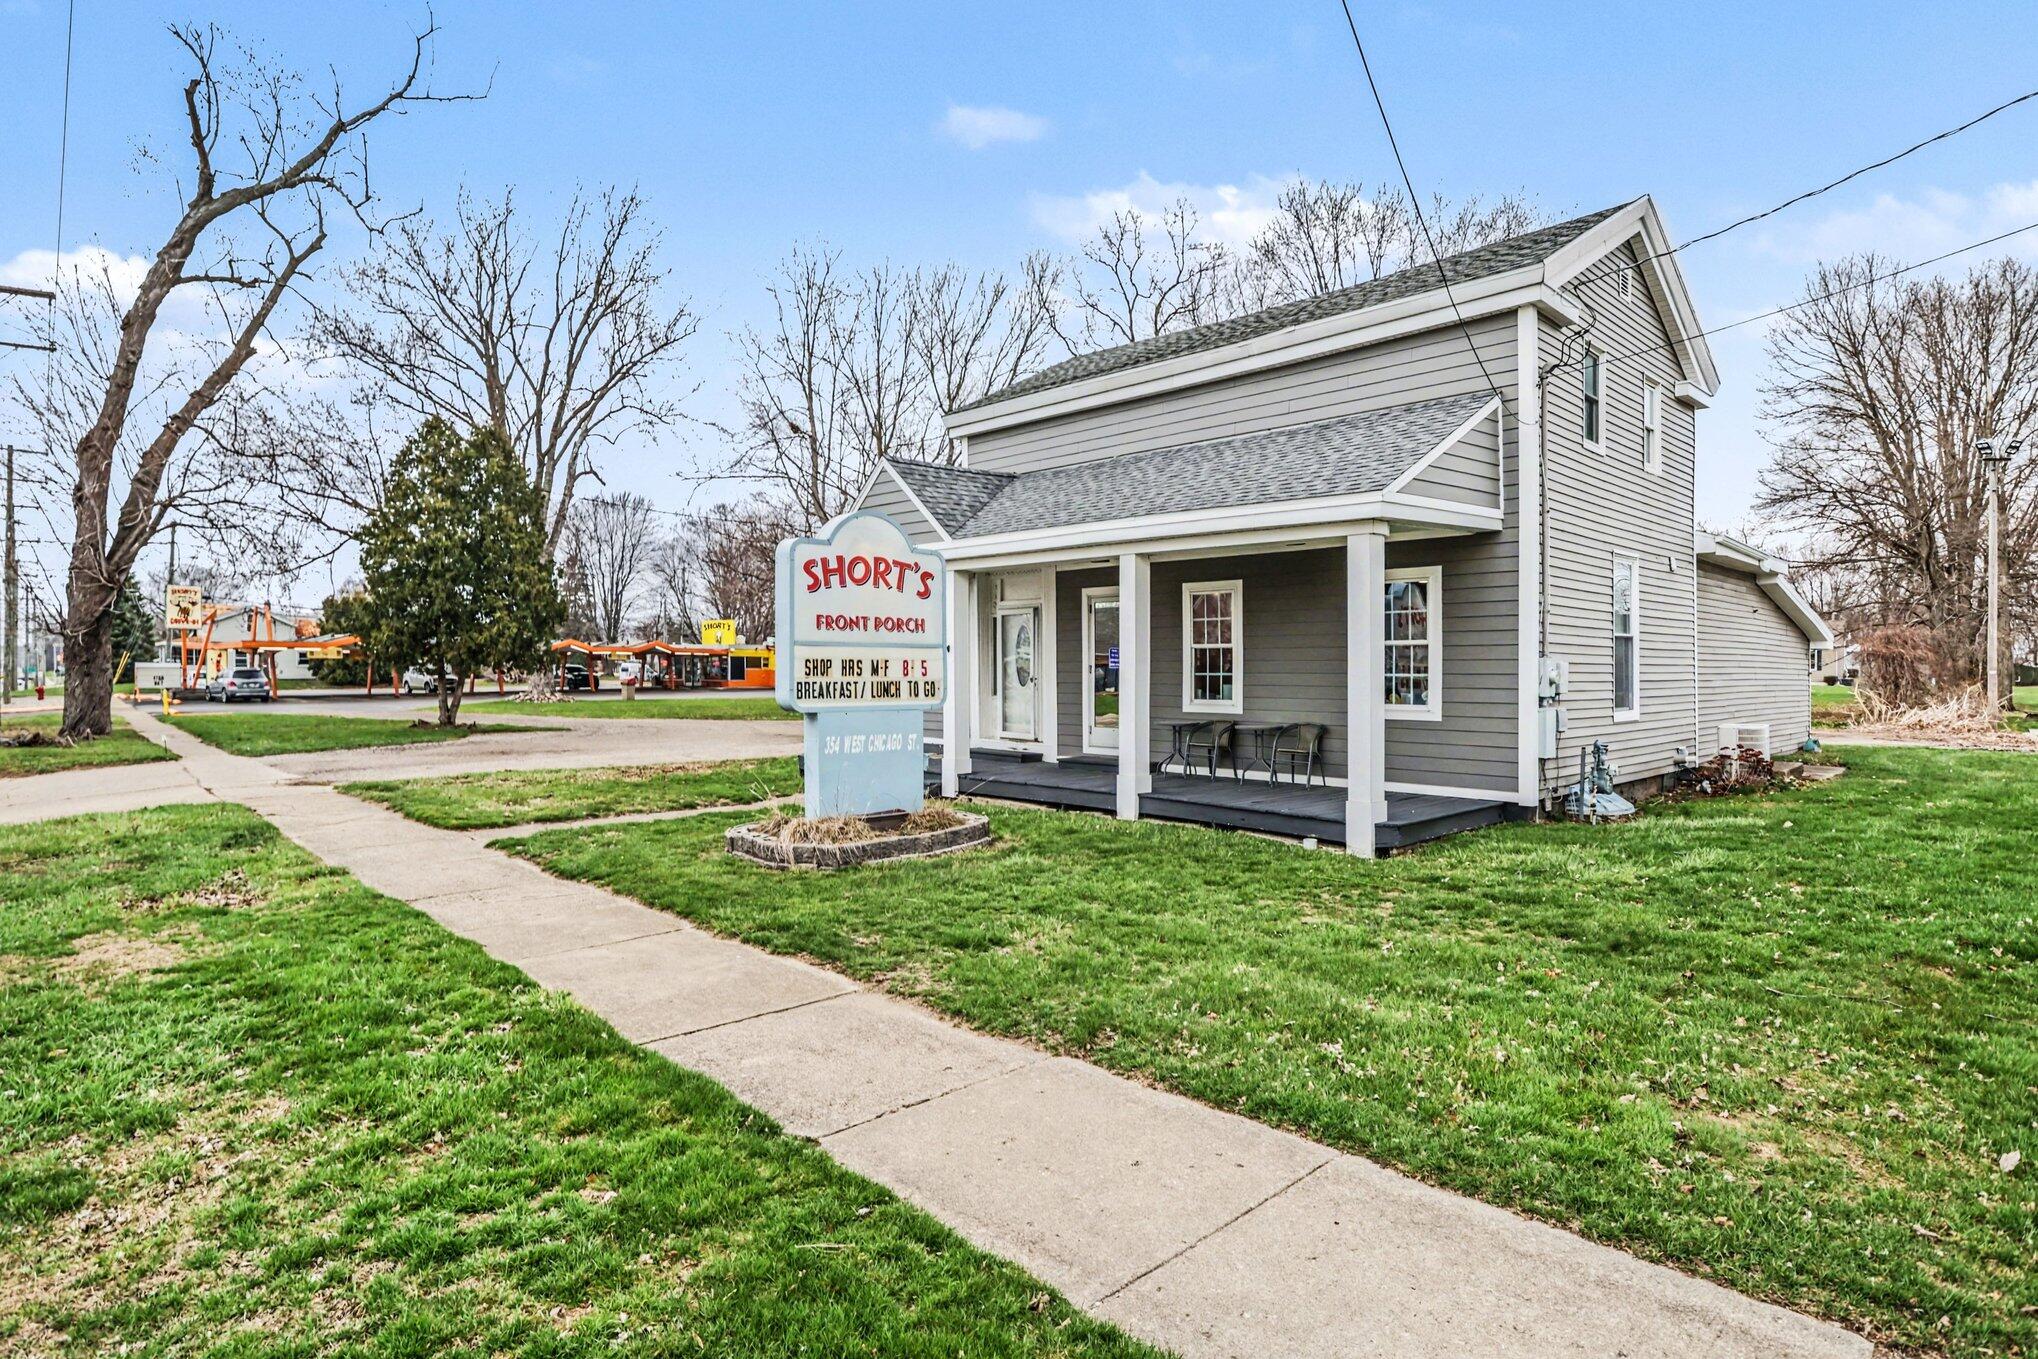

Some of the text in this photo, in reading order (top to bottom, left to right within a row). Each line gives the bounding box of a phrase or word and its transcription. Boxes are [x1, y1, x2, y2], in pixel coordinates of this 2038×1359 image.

[803, 555, 935, 600] SHORT'S
[816, 614, 926, 633] FRONT PORCH
[804, 658, 832, 677] SHOP
[841, 659, 863, 677] HRS
[871, 681, 901, 699] LUNCH
[908, 681, 919, 698] TO
[825, 735, 840, 754] 354
[844, 734, 866, 754] WEST
[868, 733, 902, 752] CHICAGO
